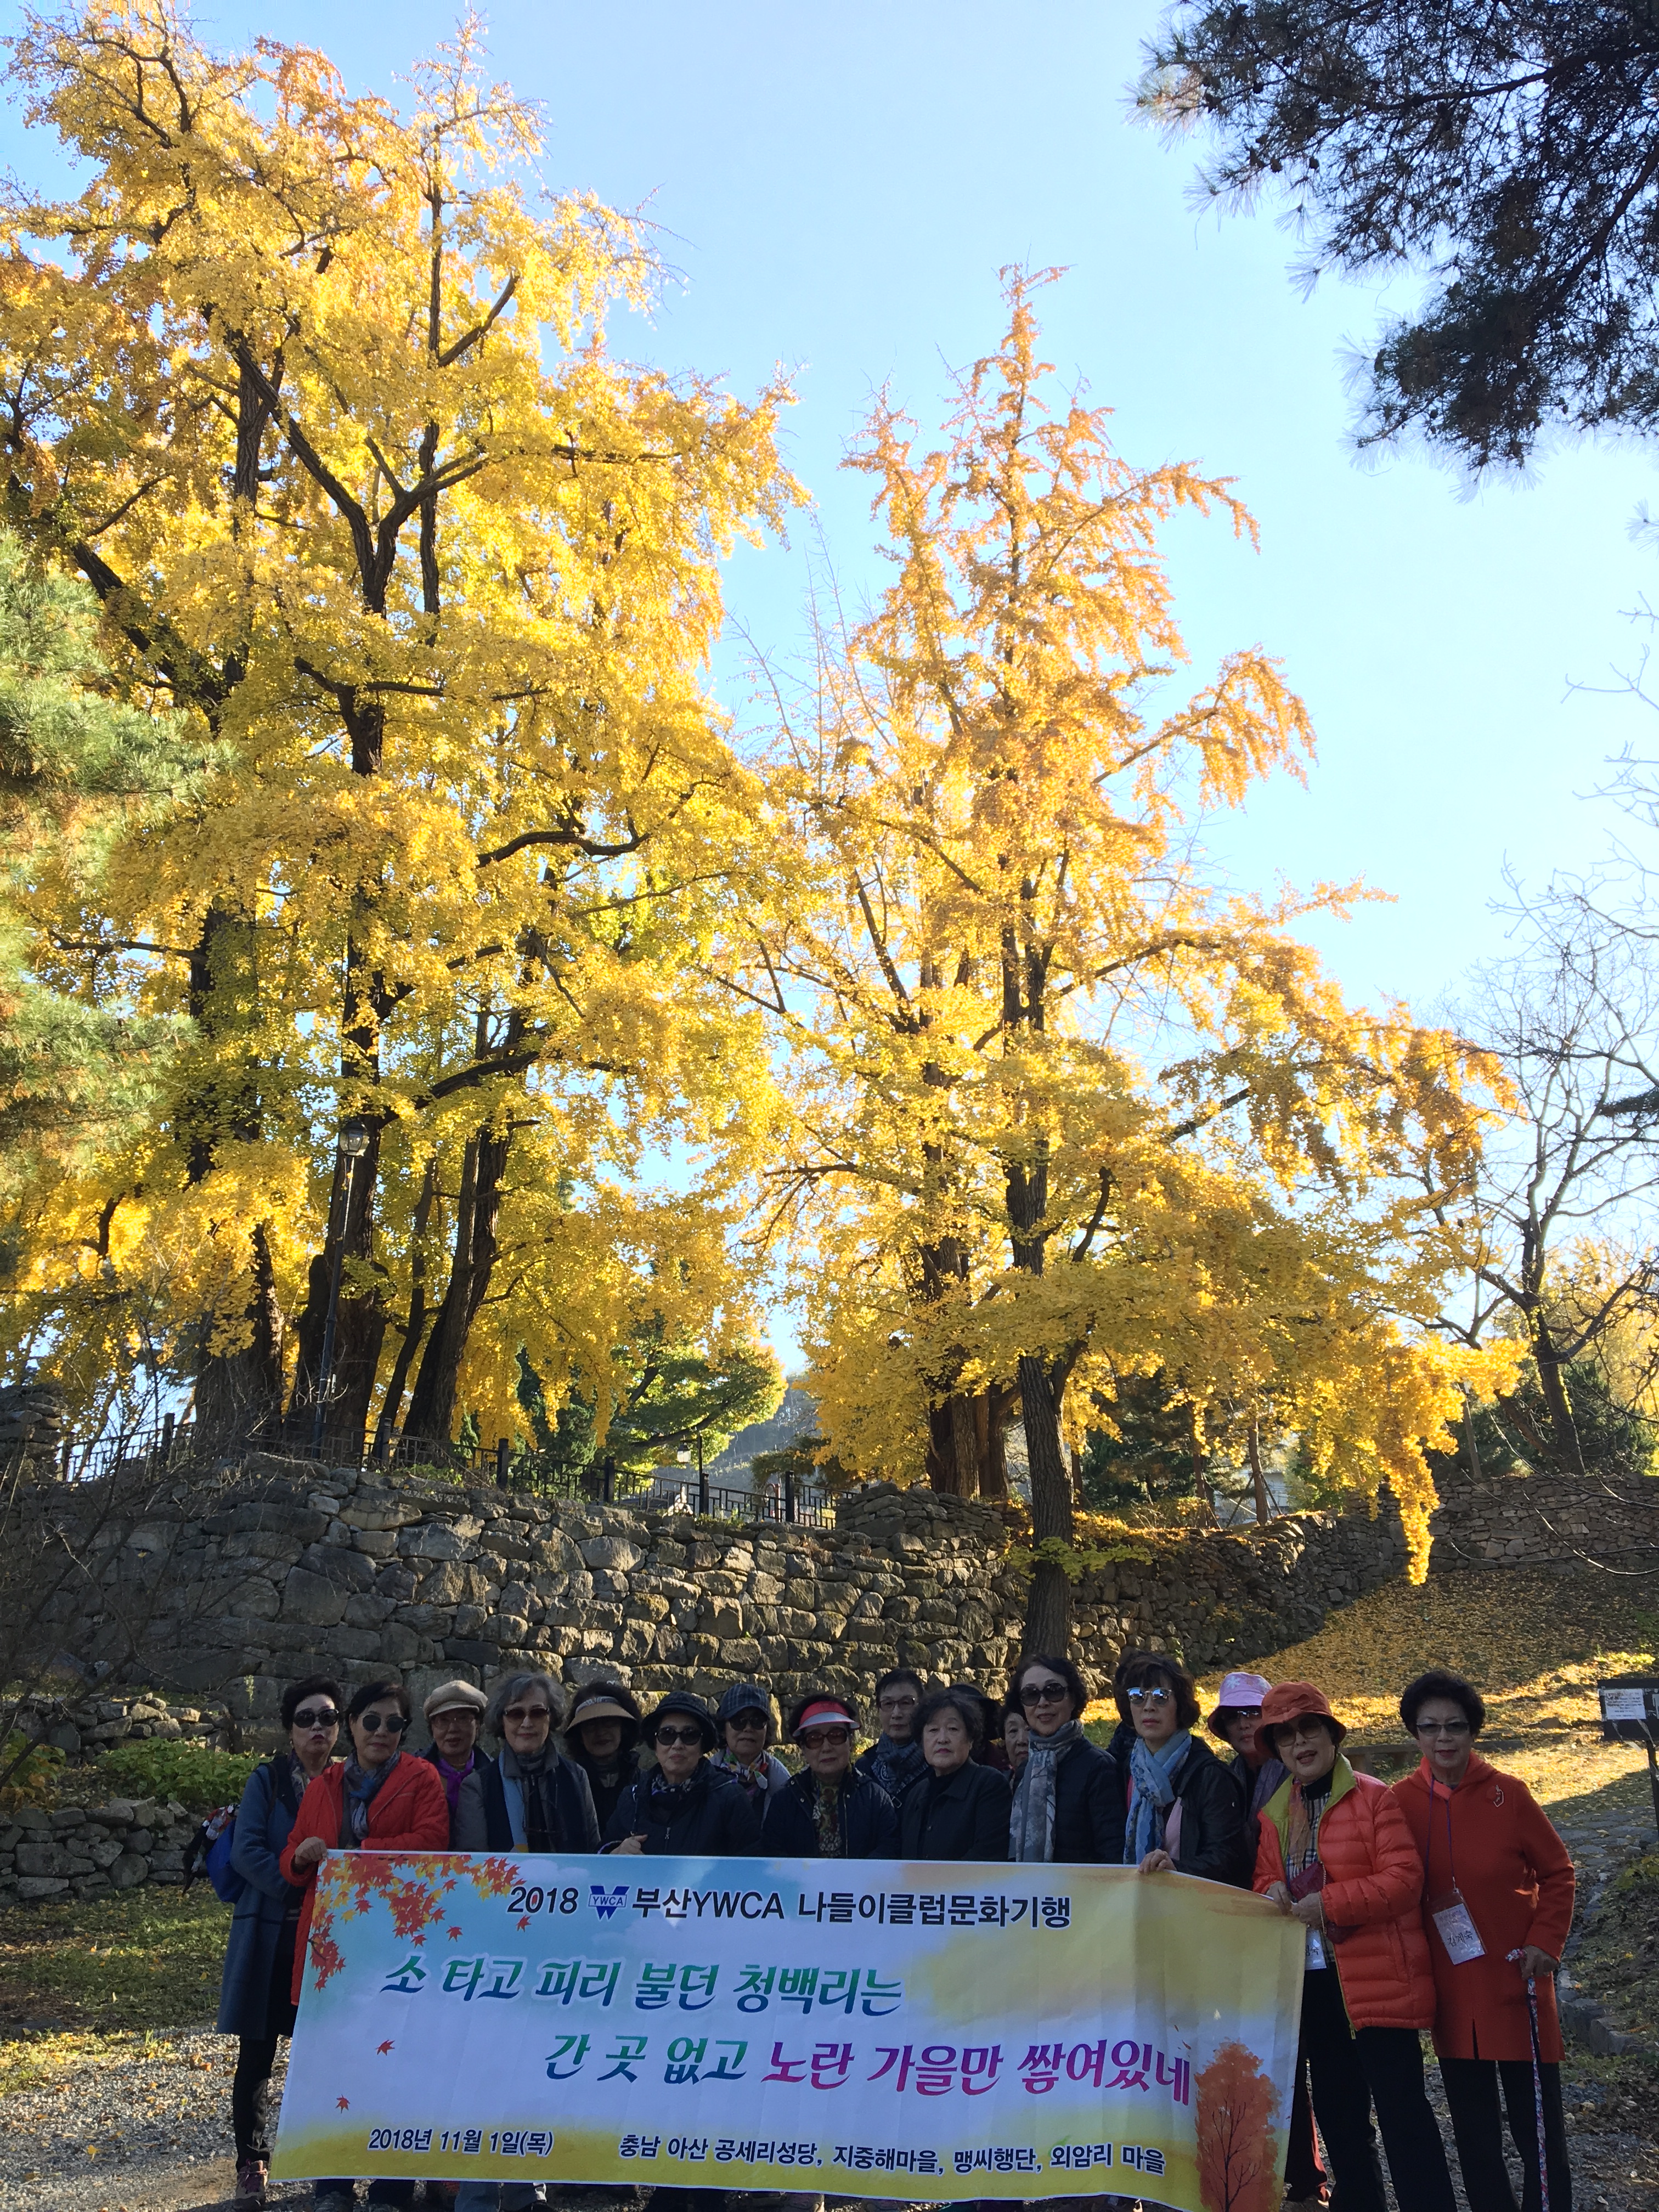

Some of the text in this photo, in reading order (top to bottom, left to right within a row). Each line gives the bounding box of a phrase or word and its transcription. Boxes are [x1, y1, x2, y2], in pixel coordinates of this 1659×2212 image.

[507, 1886, 1071, 1928] 2018 YWCA 부산YWCA 나들이클럽문화기행
[381, 1955, 902, 2016] 소 타고 피리 불던 청백리는
[546, 2034, 1191, 2107] 간 곳 없고 노란 가을만 쌓여있네
[369, 2128, 555, 2157] 2018년 11월 1일(목)
[619, 2134, 1166, 2176] 충남 아산 공세리성당, 지중해마을, 맹씨행단, 외암리 마을
